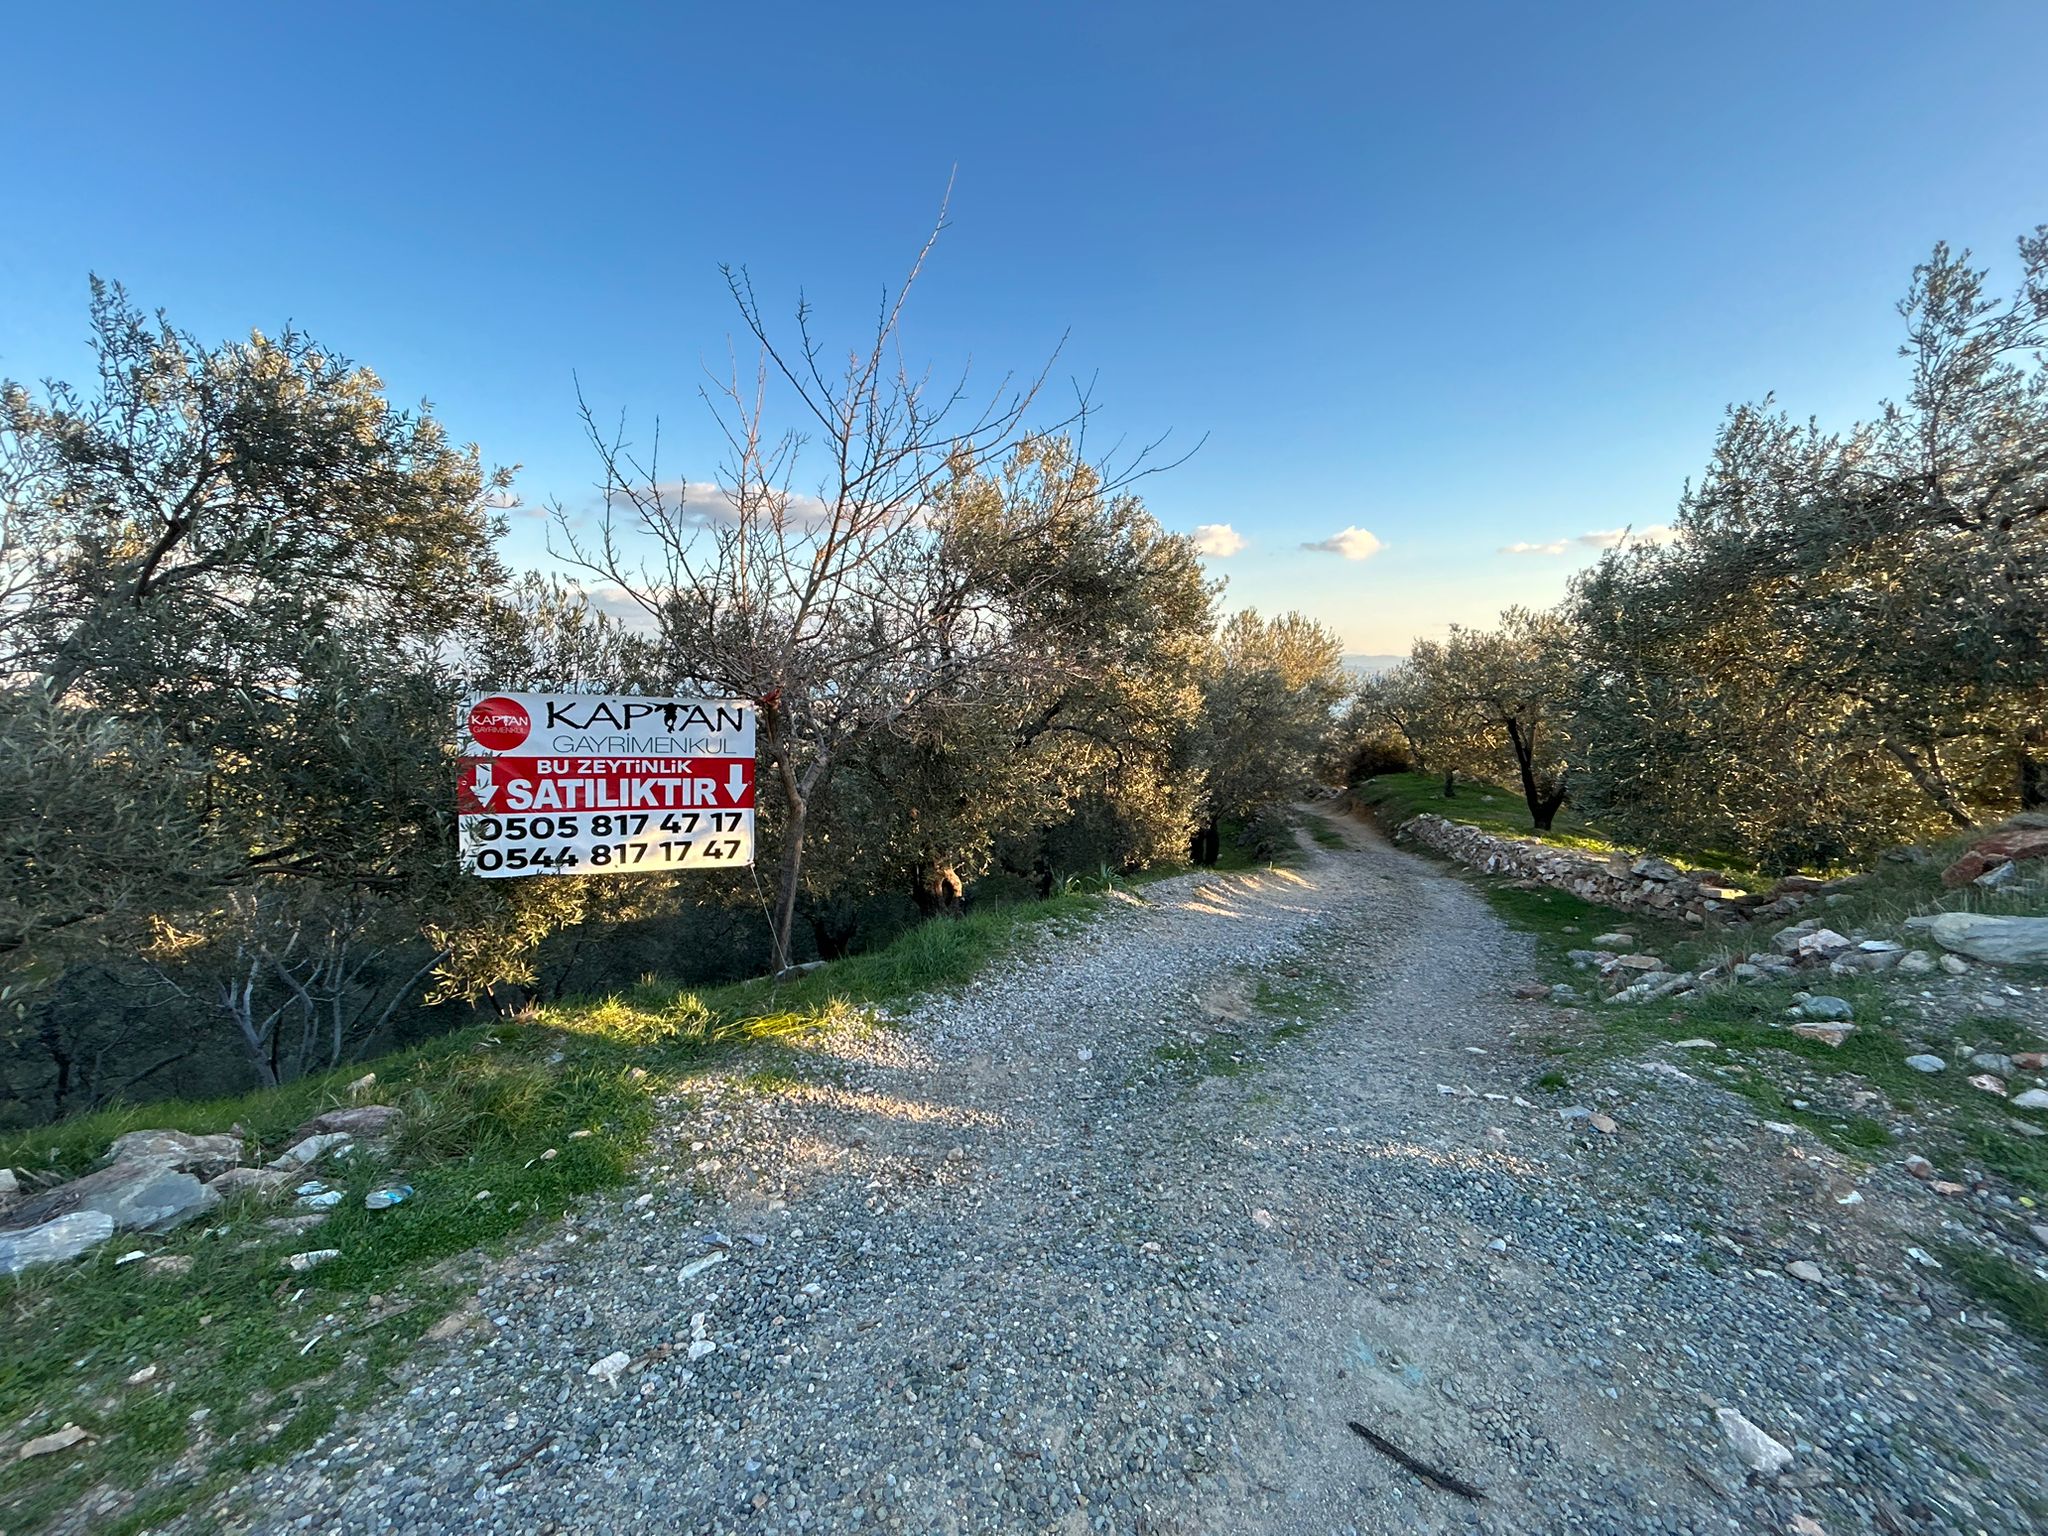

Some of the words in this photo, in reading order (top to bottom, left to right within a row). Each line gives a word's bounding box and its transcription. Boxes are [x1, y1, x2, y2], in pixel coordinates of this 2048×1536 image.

[552, 733, 736, 754] GAYRİMENKUL
[537, 760, 569, 774] BU
[506, 778, 717, 810] SATILIKTIR
[477, 815, 579, 841] 0505
[590, 815, 649, 837] 817
[660, 813, 700, 834] 47
[710, 812, 743, 832] 17
[476, 846, 579, 871] 0544
[590, 843, 648, 866] 817
[659, 841, 692, 862] 17
[703, 840, 741, 859] 47
